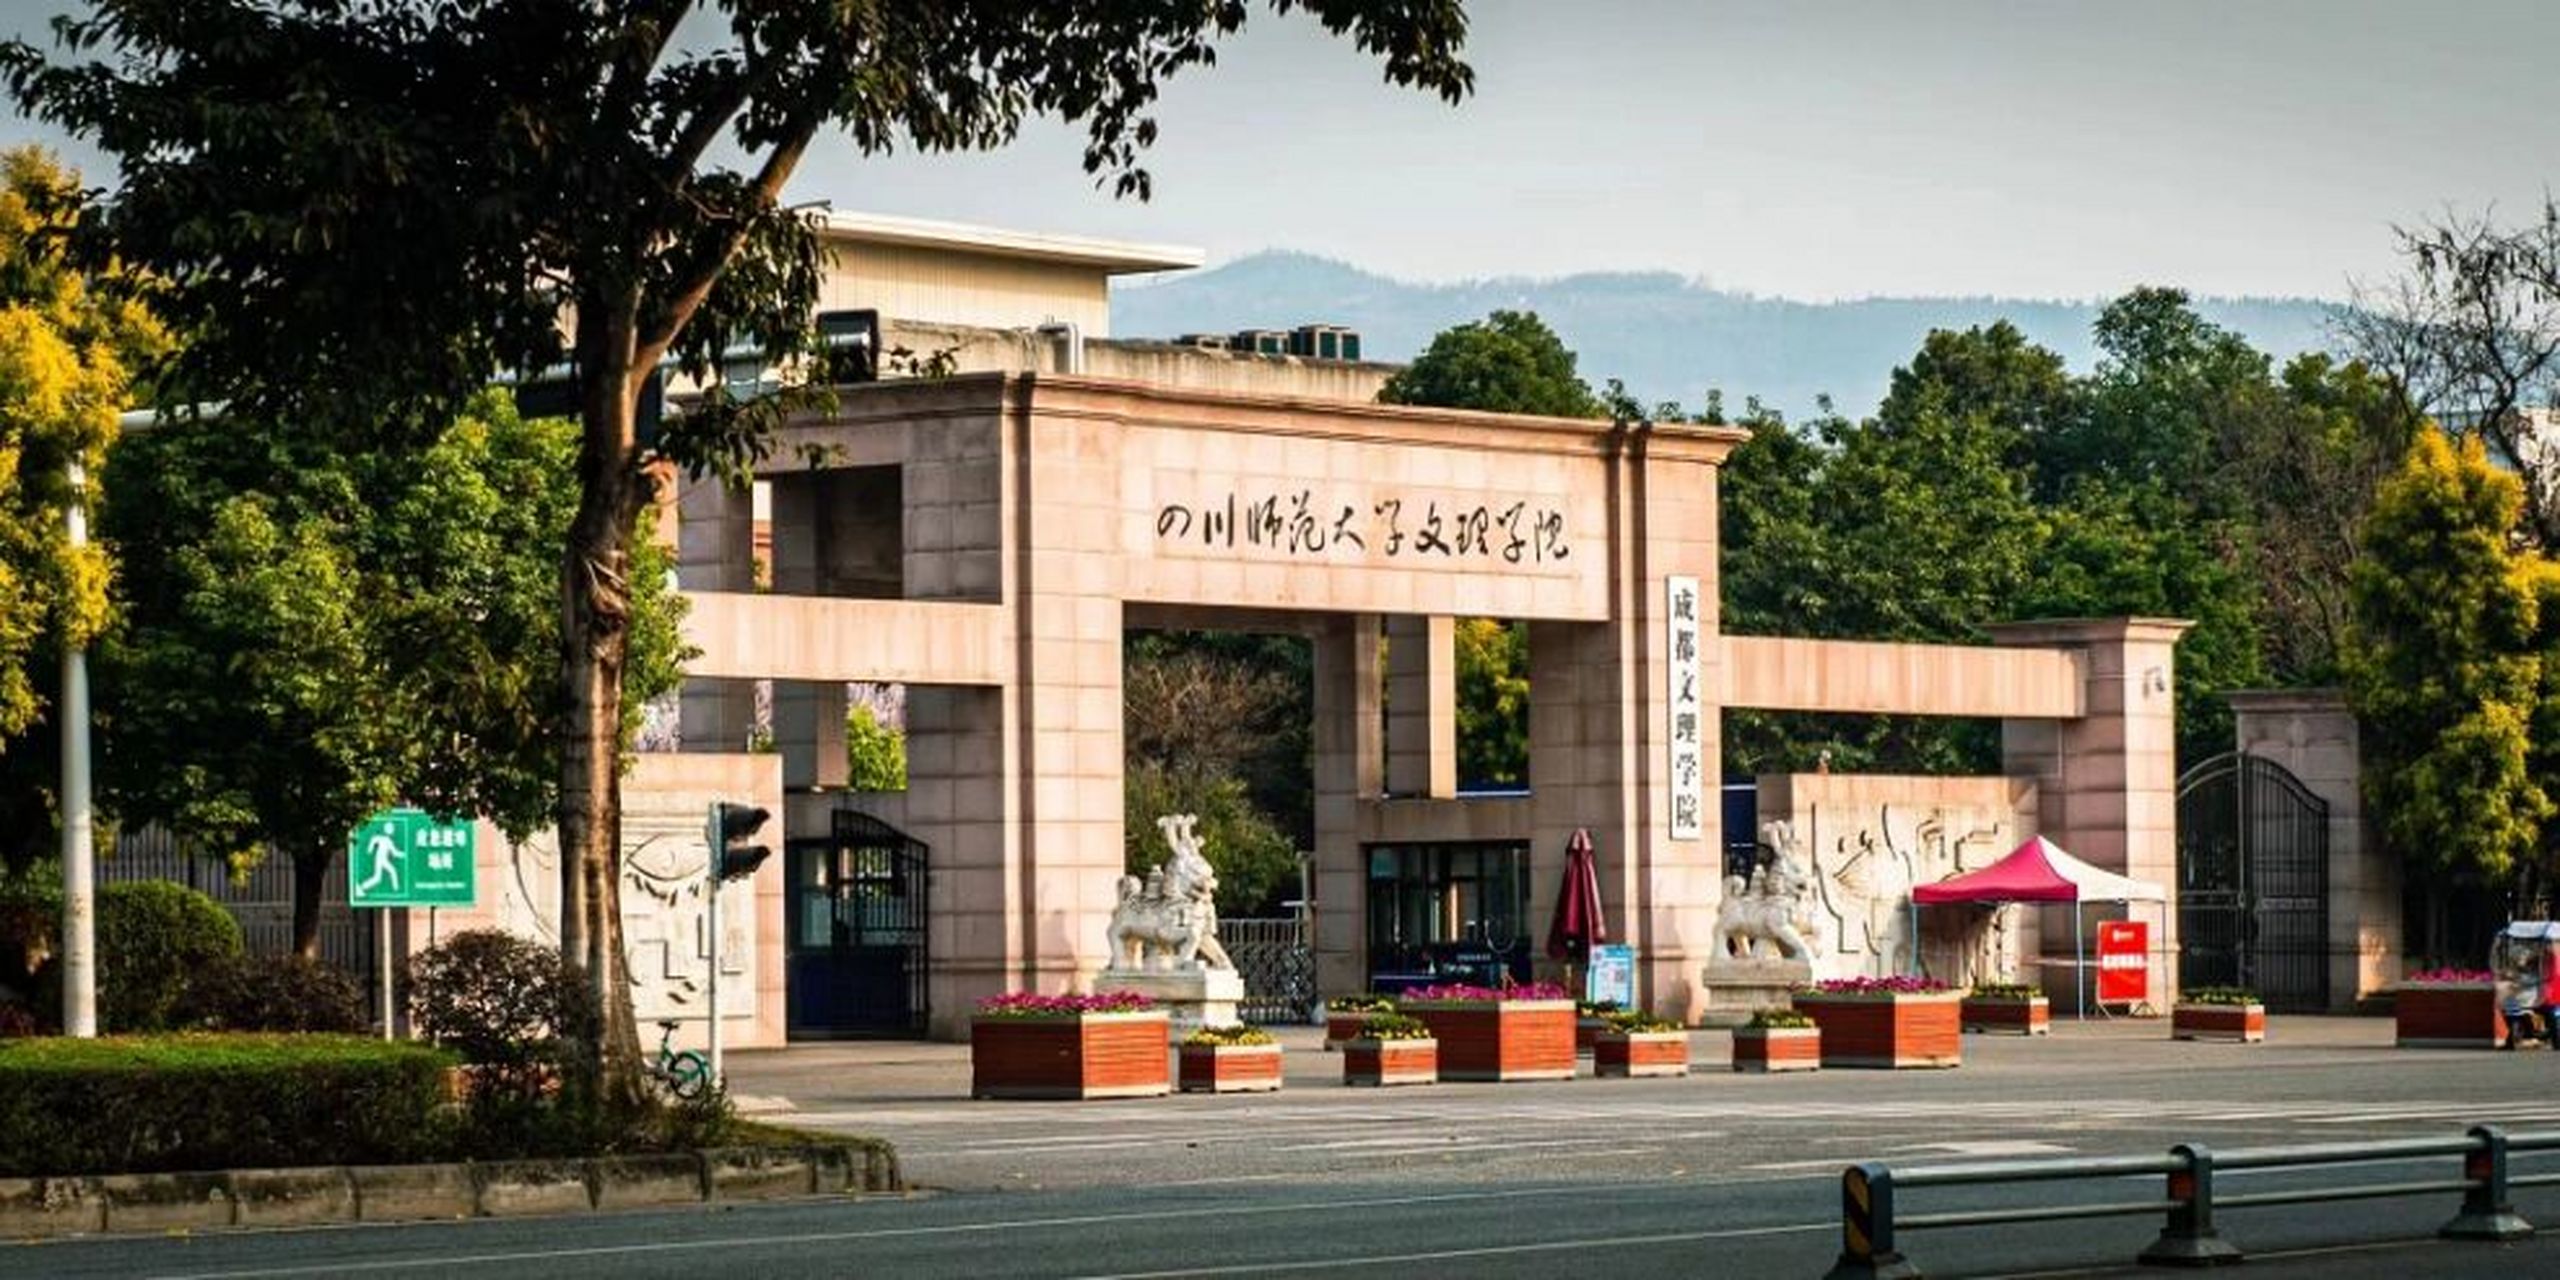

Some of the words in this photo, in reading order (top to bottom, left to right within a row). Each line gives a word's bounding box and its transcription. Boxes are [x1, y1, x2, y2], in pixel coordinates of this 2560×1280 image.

[1157, 490, 1569, 564] 四川师范大学文理学院
[1673, 587, 1697, 829] 成都文理学院
